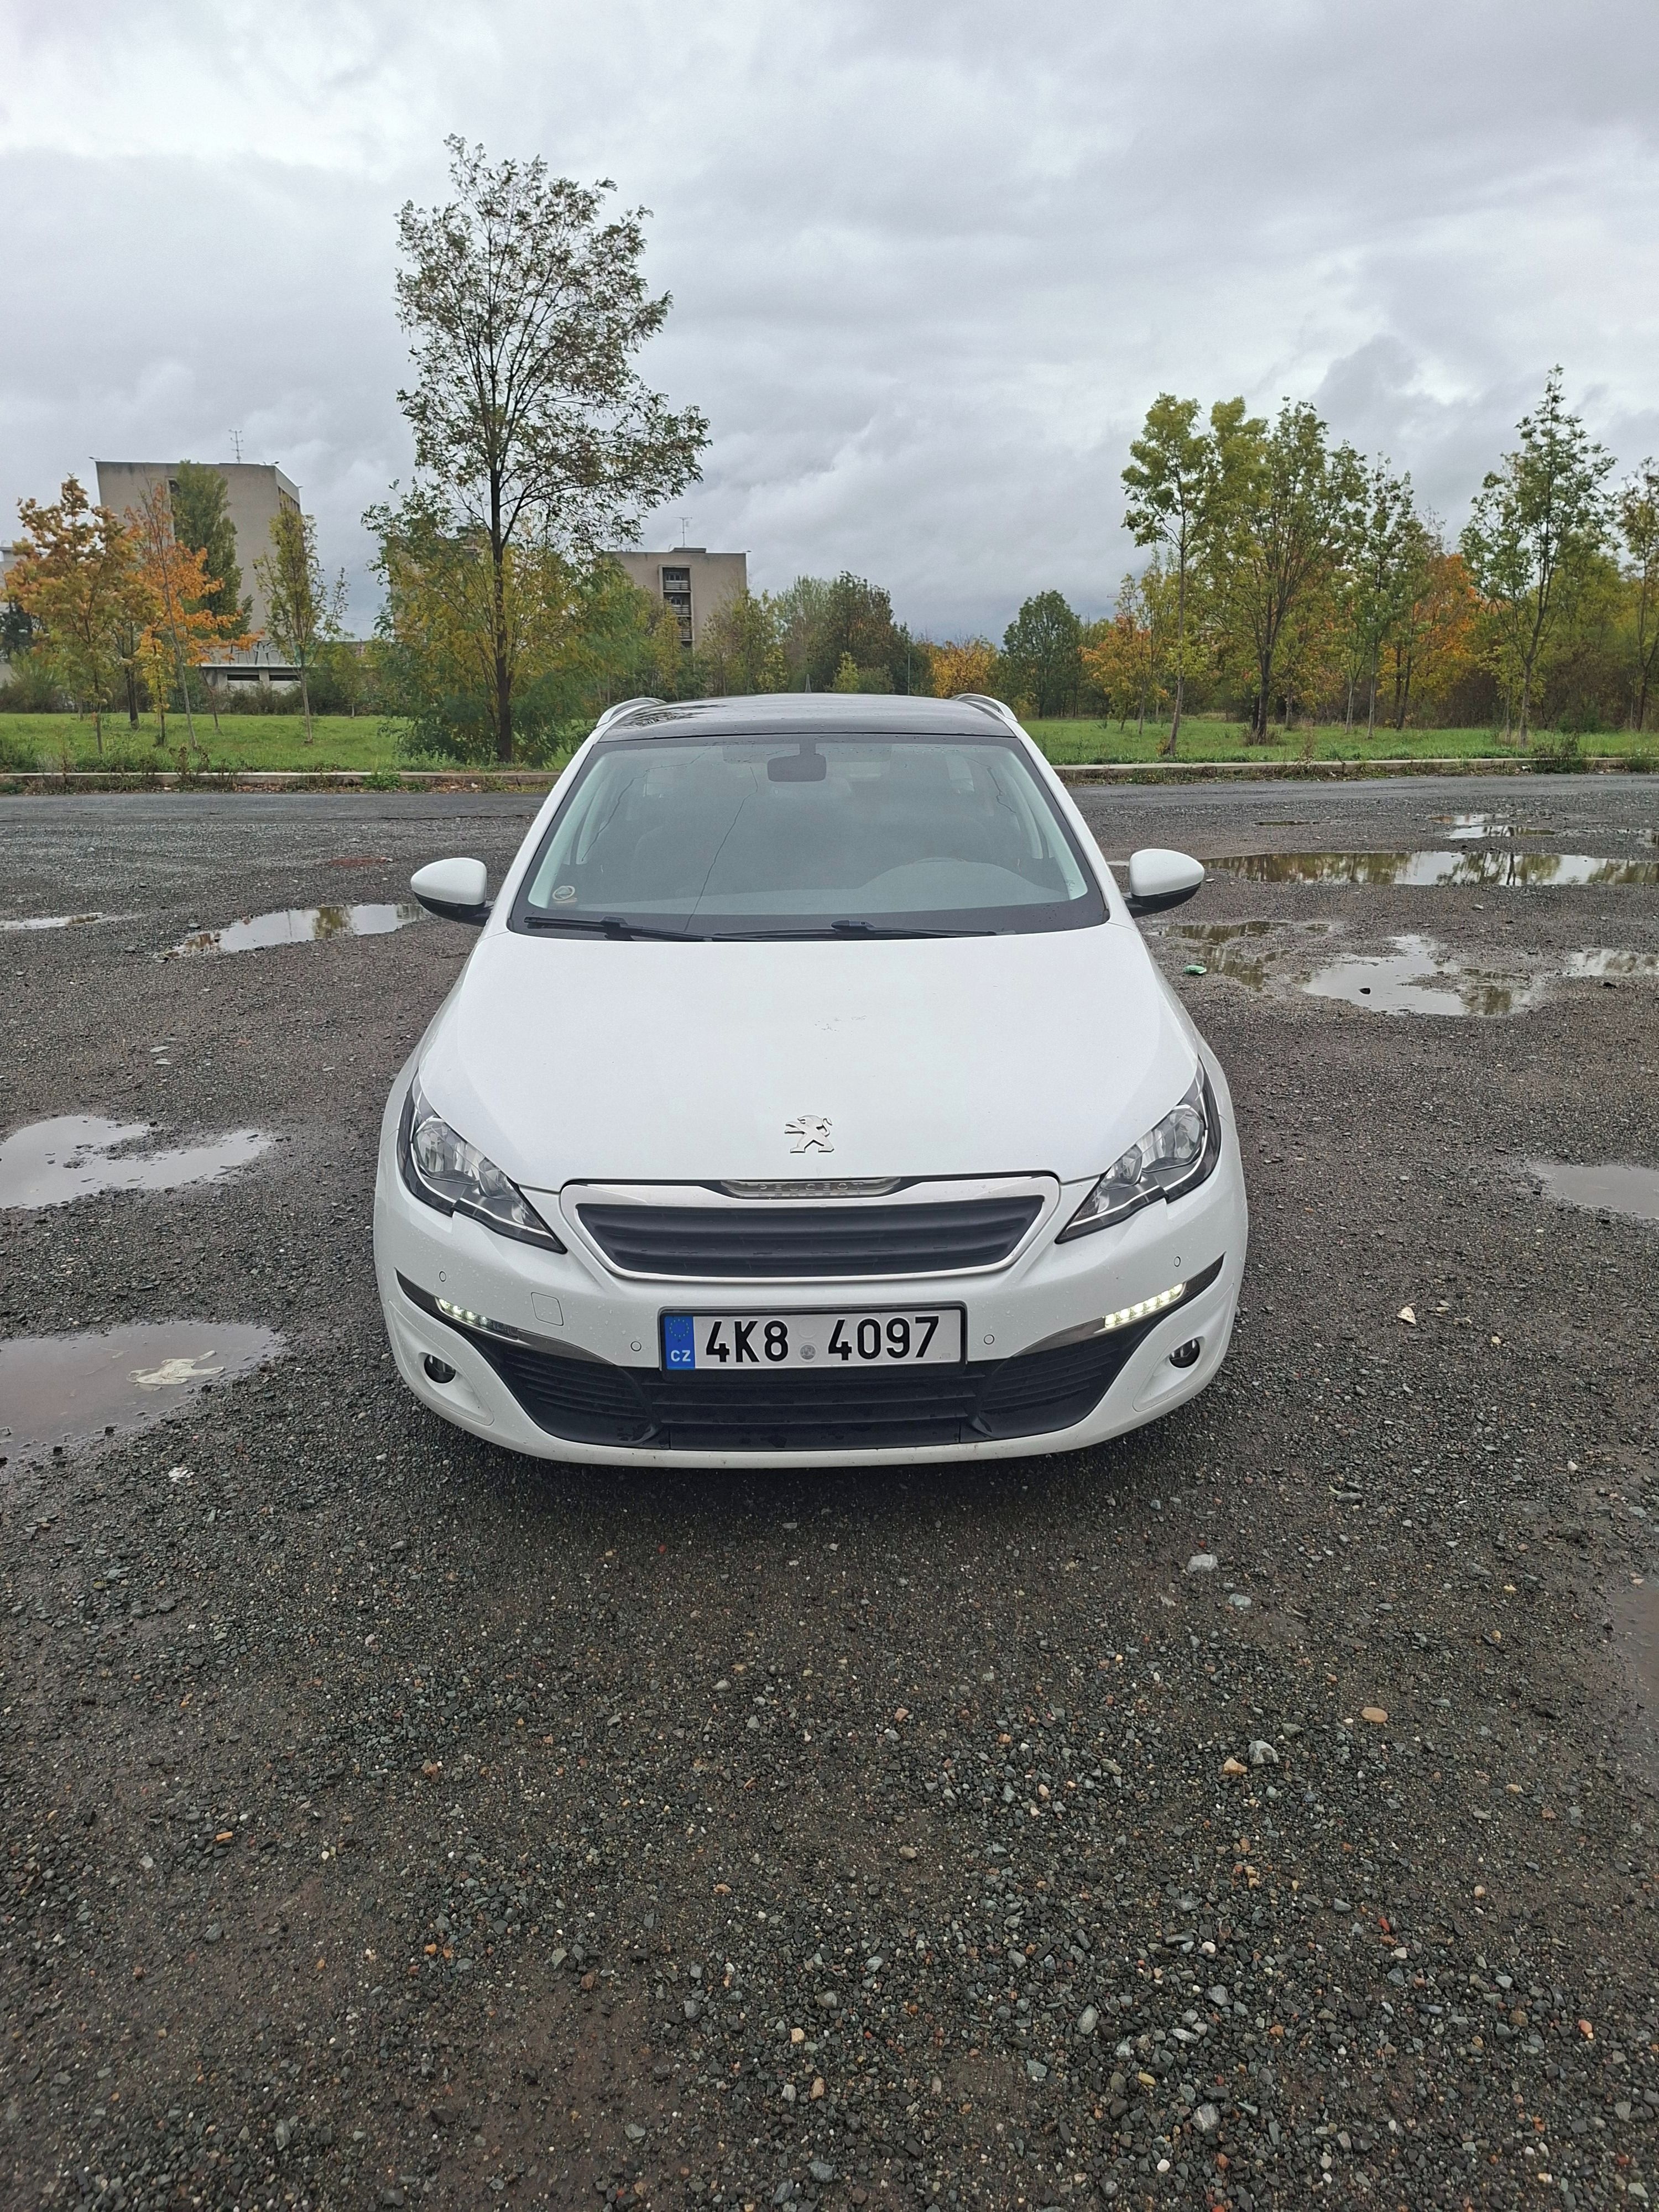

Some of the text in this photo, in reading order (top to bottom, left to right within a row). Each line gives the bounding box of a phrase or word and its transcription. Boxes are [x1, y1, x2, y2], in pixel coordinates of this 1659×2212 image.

[705, 1315, 940, 1363] 4K8 4097
[670, 1349, 691, 1362] CZ
